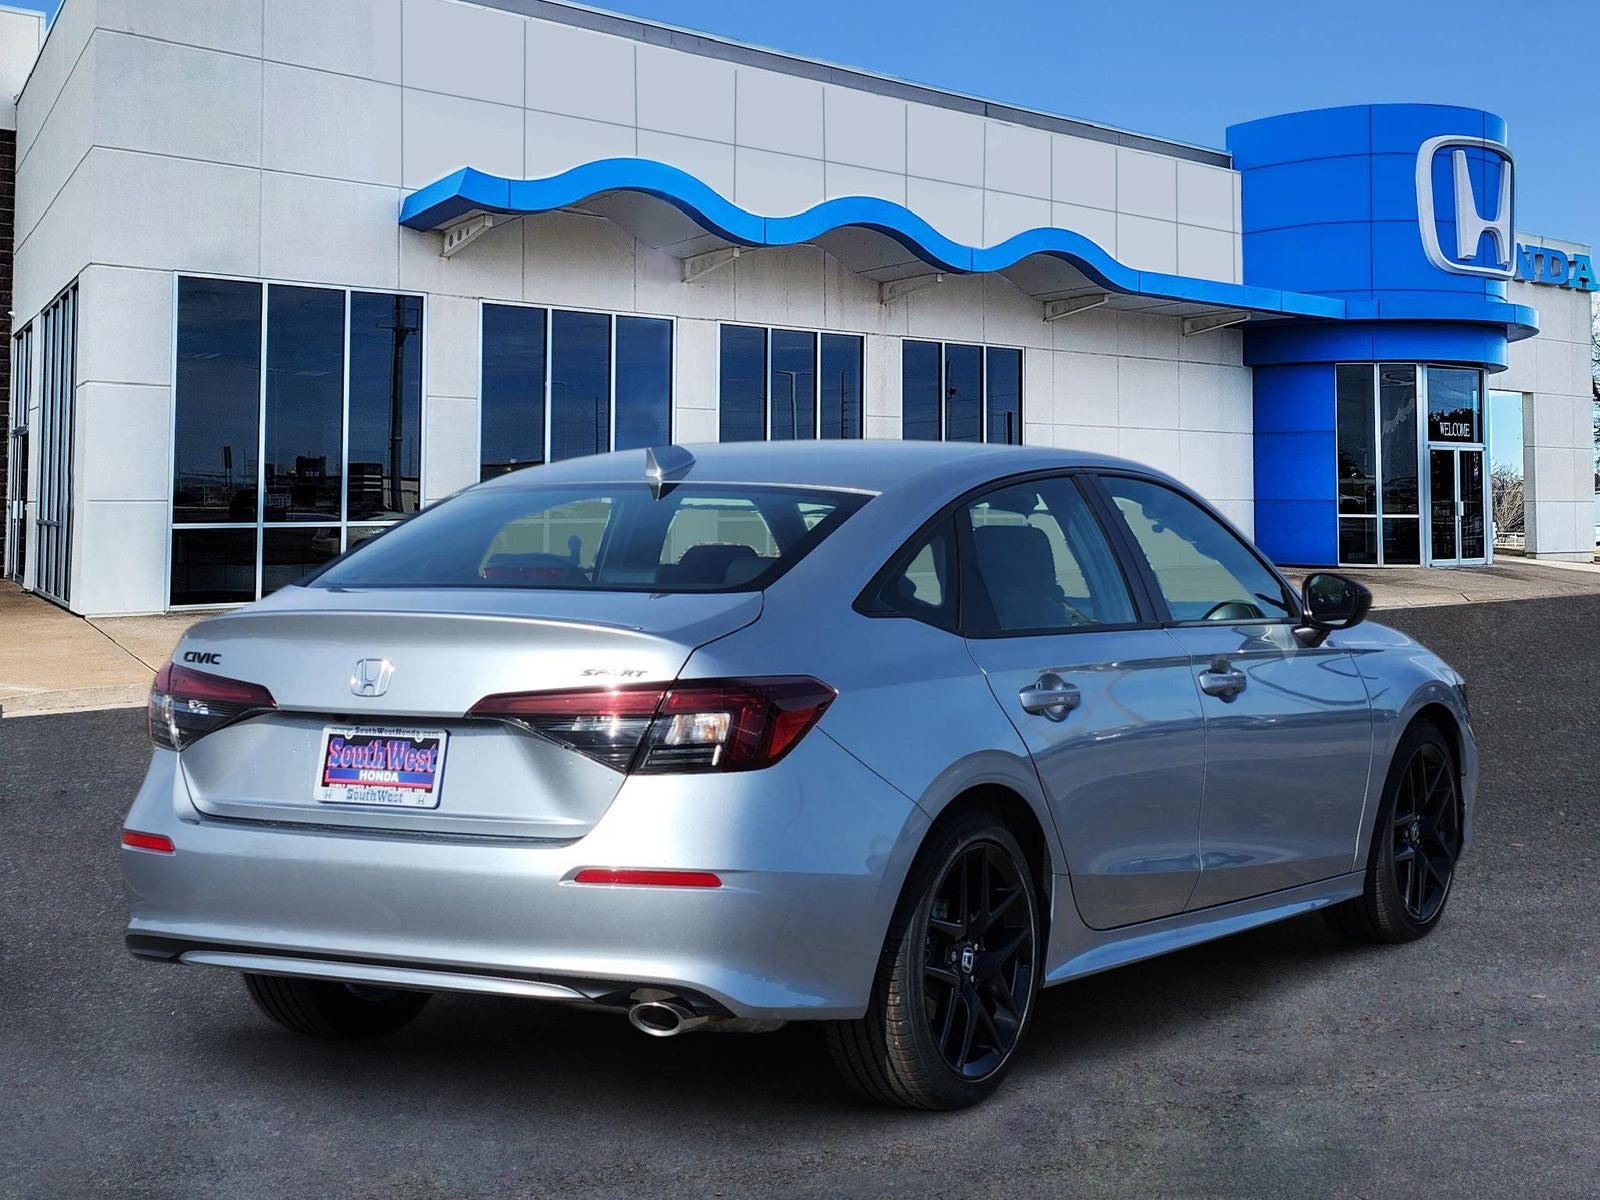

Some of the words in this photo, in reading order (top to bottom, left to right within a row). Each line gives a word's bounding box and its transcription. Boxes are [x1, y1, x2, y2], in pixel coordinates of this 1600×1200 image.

[1440, 422, 1471, 437] WELCOME
[183, 651, 222, 665] CIVIC
[580, 668, 648, 677] SPRT
[359, 769, 399, 782] HONDA
